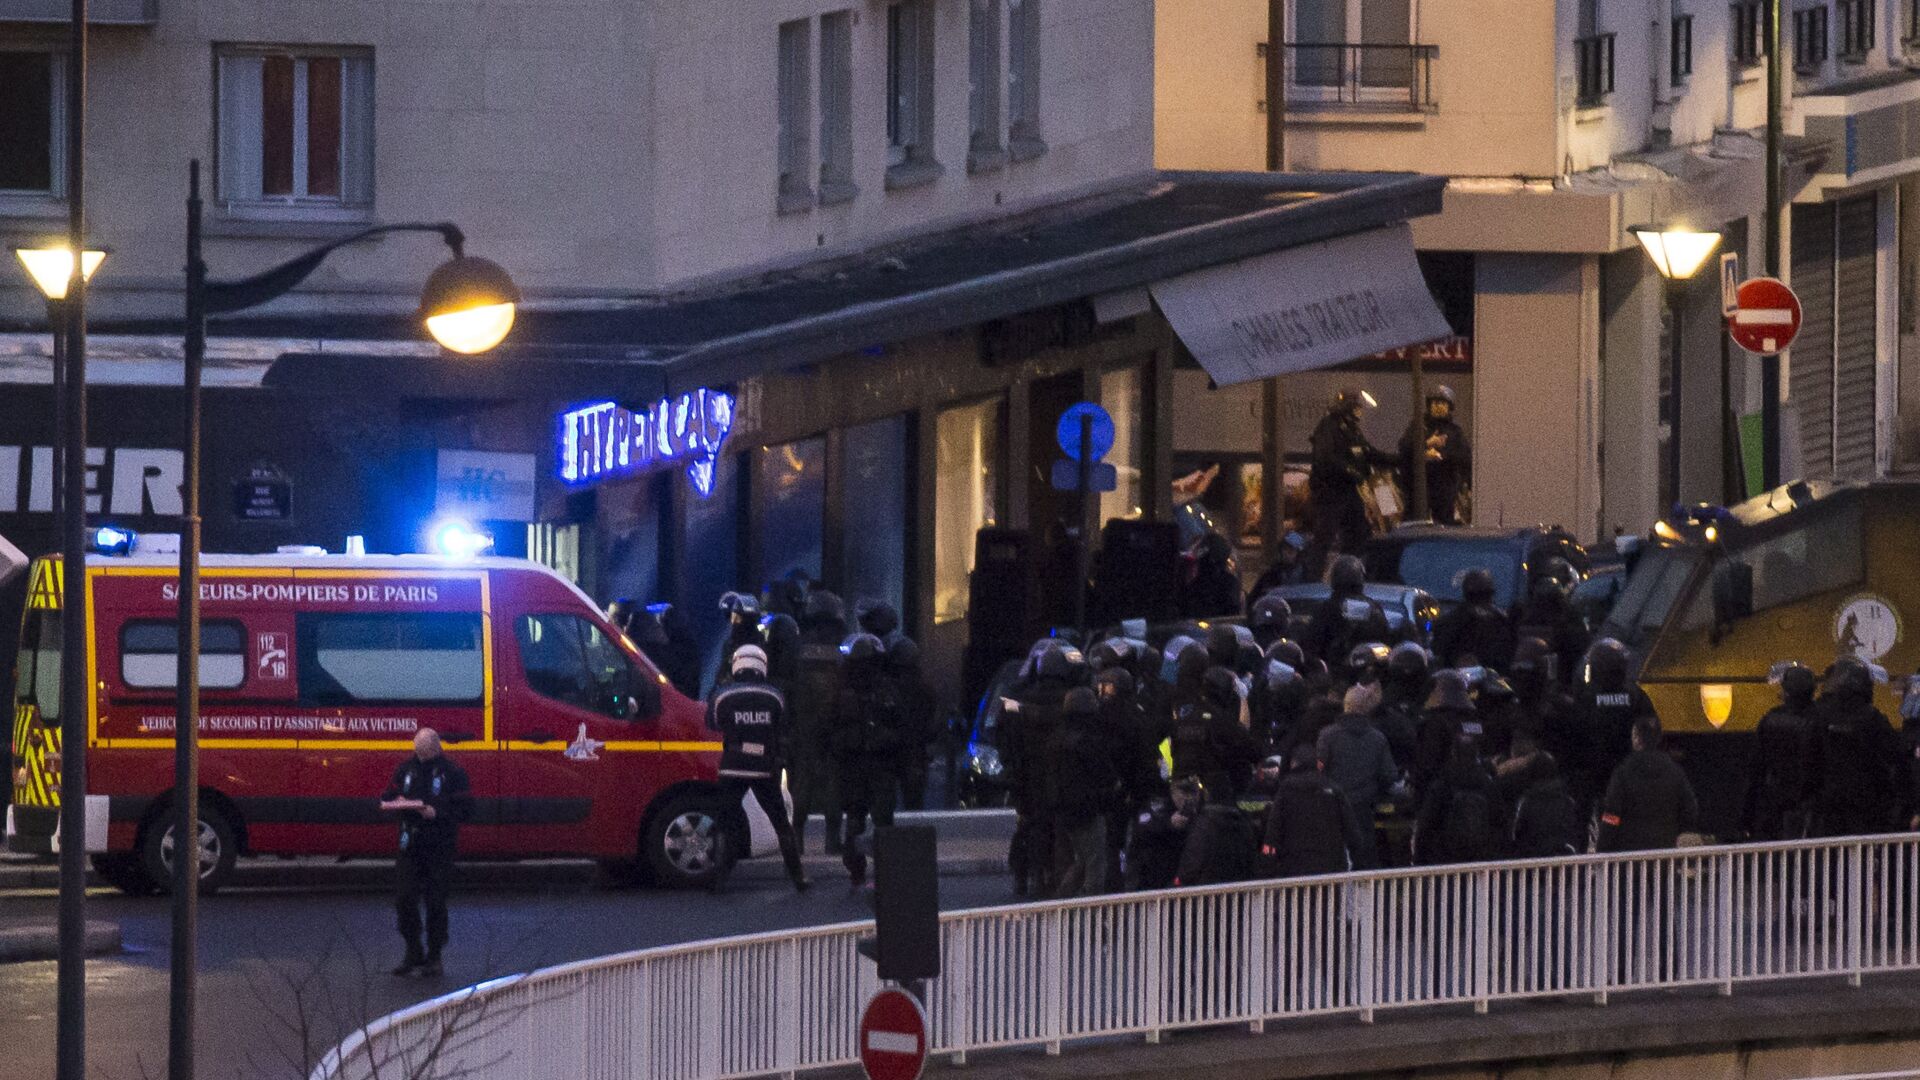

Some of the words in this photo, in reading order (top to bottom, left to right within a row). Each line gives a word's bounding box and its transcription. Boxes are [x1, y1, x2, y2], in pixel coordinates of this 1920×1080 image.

[0, 445, 184, 515] IER
[162, 583, 350, 602] SEURS-POMPIERS
[354, 584, 380, 602] DE
[383, 585, 438, 602] PARIS
[260, 634, 275, 652] 112
[272, 661, 286, 679] 18
[1596, 694, 1631, 706] POLICE
[141, 716, 177, 731] VEHIC
[209, 716, 259, 730] SECOURS
[259, 716, 273, 731] ET
[273, 716, 346, 731] D'ASSISTANCE
[347, 717, 369, 731] AUX
[369, 718, 418, 731] VICTIMES
[734, 711, 772, 725] POLICE
